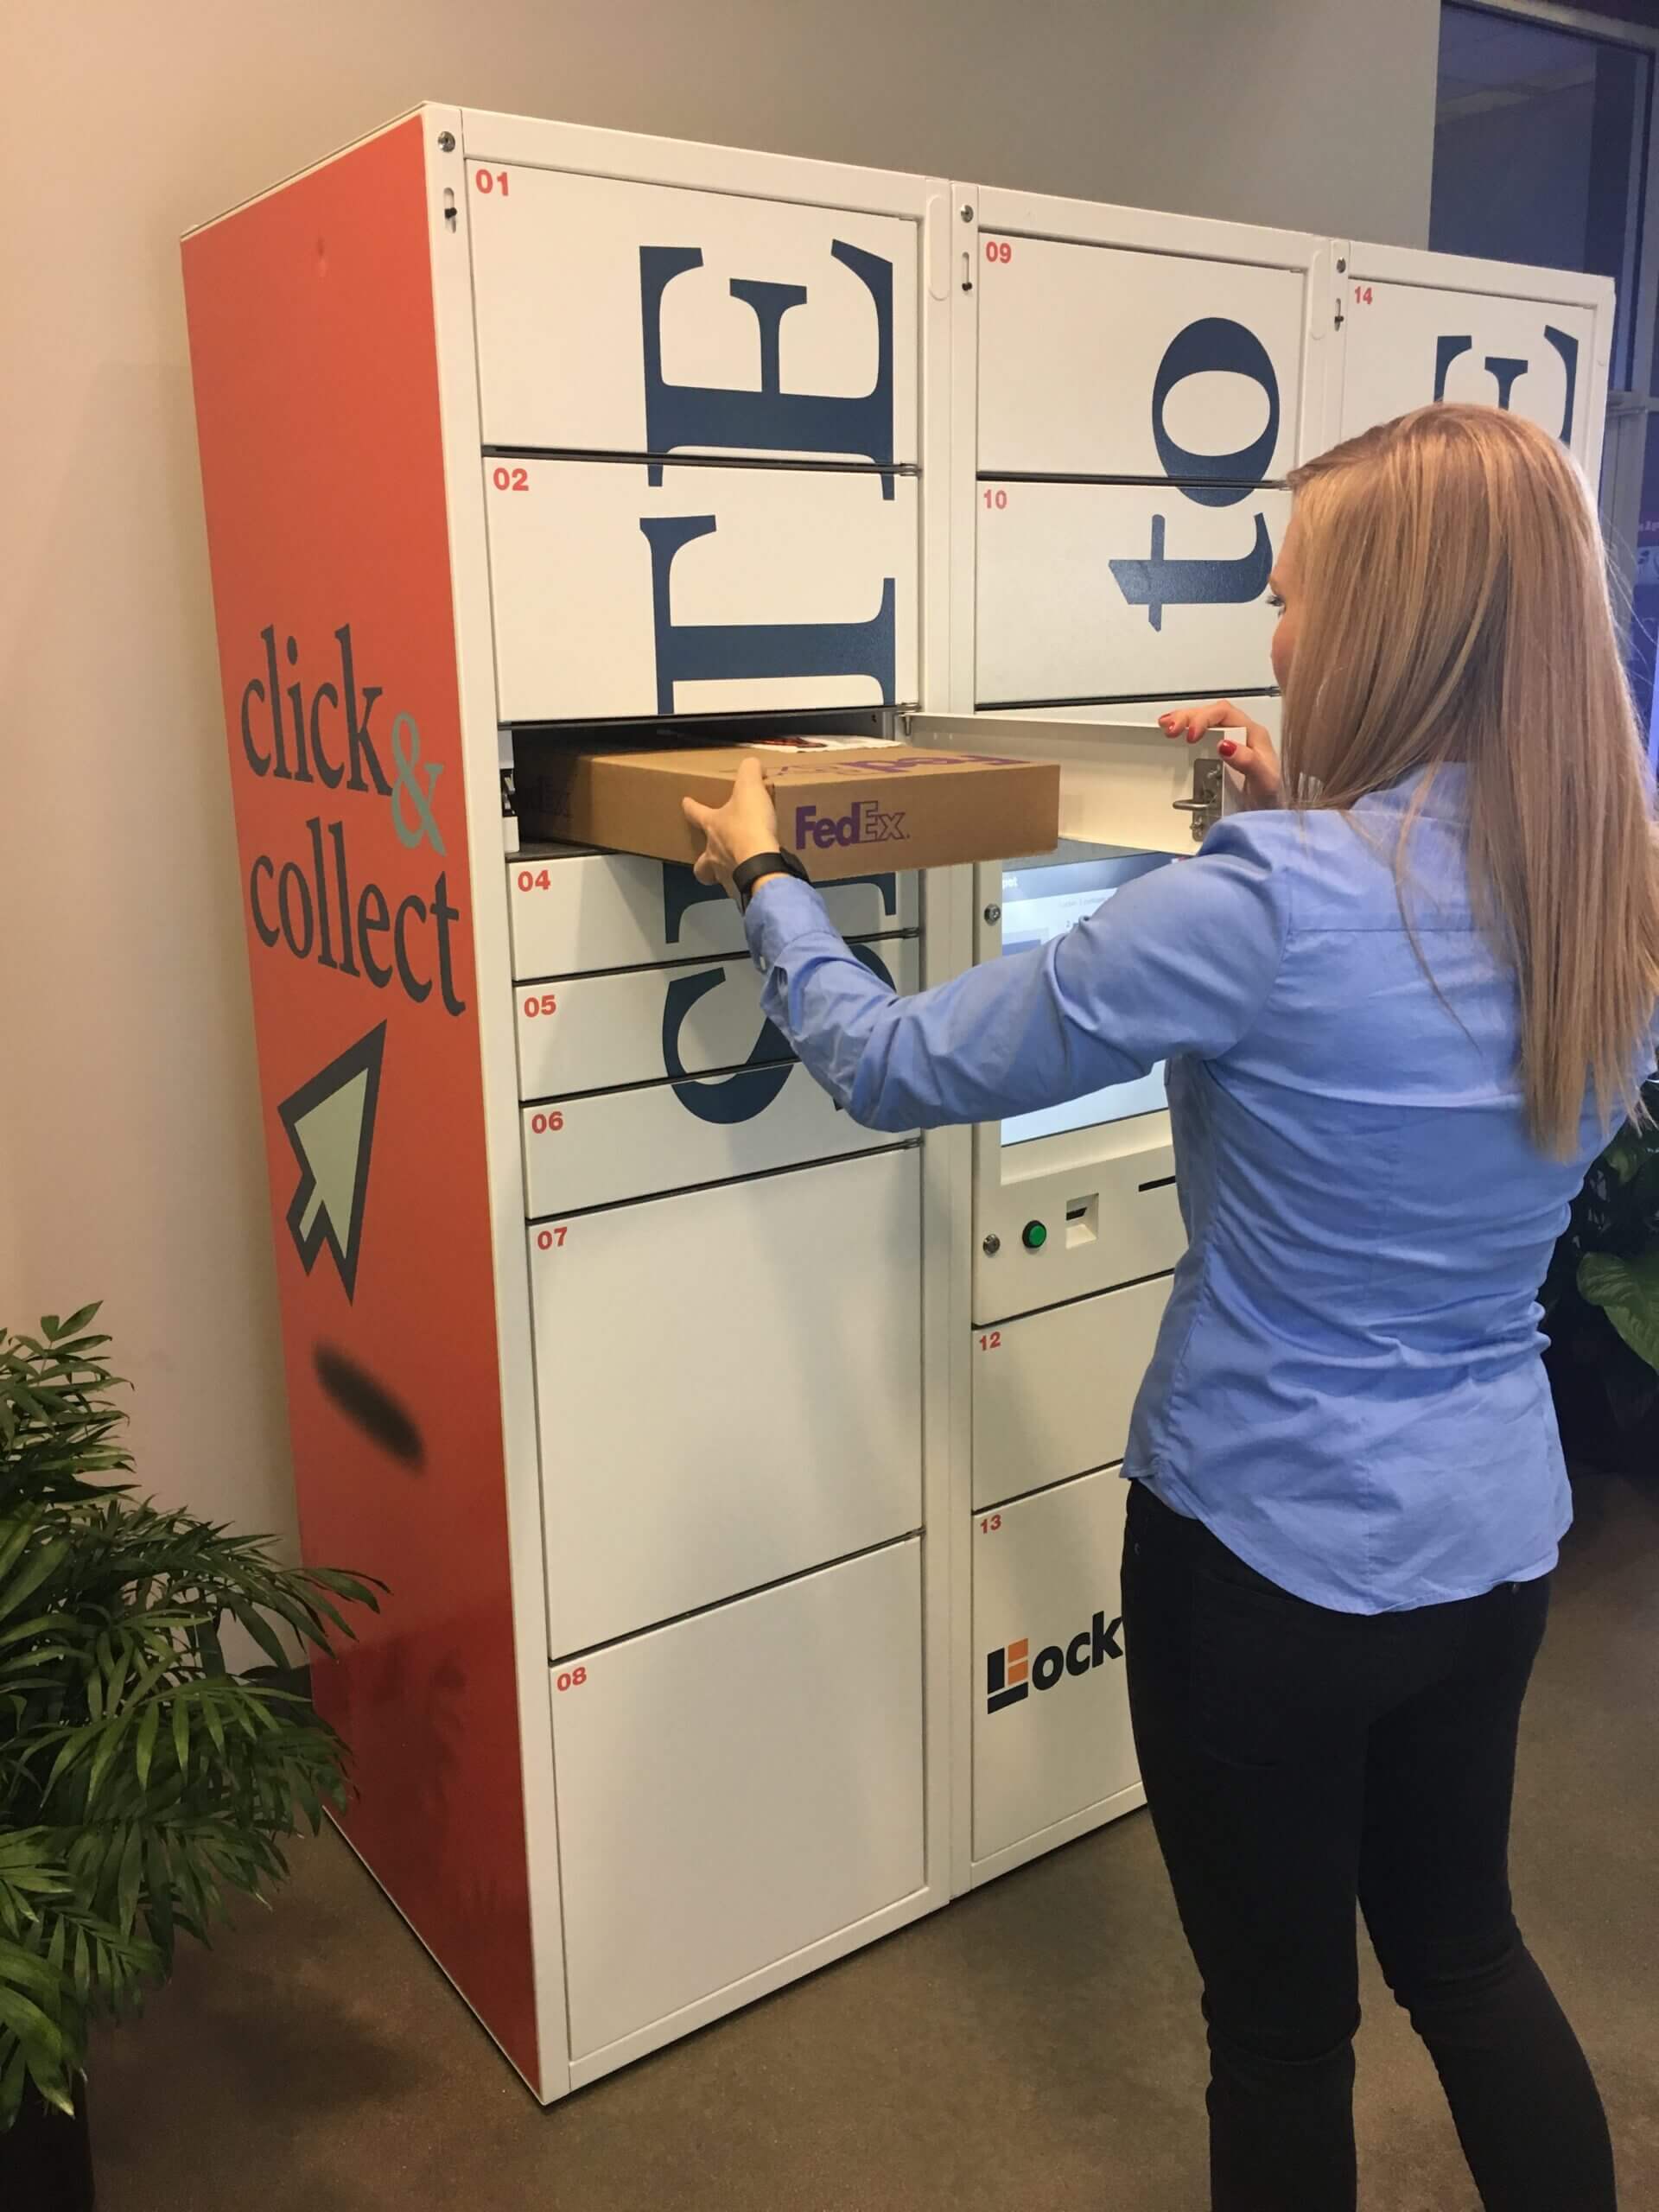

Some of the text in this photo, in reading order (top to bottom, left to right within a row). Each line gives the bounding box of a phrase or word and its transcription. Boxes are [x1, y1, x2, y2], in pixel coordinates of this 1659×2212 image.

[474, 167, 511, 199] 01
[984, 238, 1014, 265] 09
[1353, 285, 1374, 306] 14
[492, 466, 531, 493] 02
[1109, 316, 1281, 632] to
[982, 488, 1009, 510] 10
[240, 623, 447, 856] click &
[517, 868, 552, 893] 04
[250, 817, 467, 1017] collect
[522, 994, 558, 1020] 05
[531, 1110, 564, 1135] 06
[536, 1226, 569, 1250] 07
[979, 1331, 1002, 1351] 12
[980, 1514, 1002, 1535] 13
[554, 1665, 588, 1693] 08
